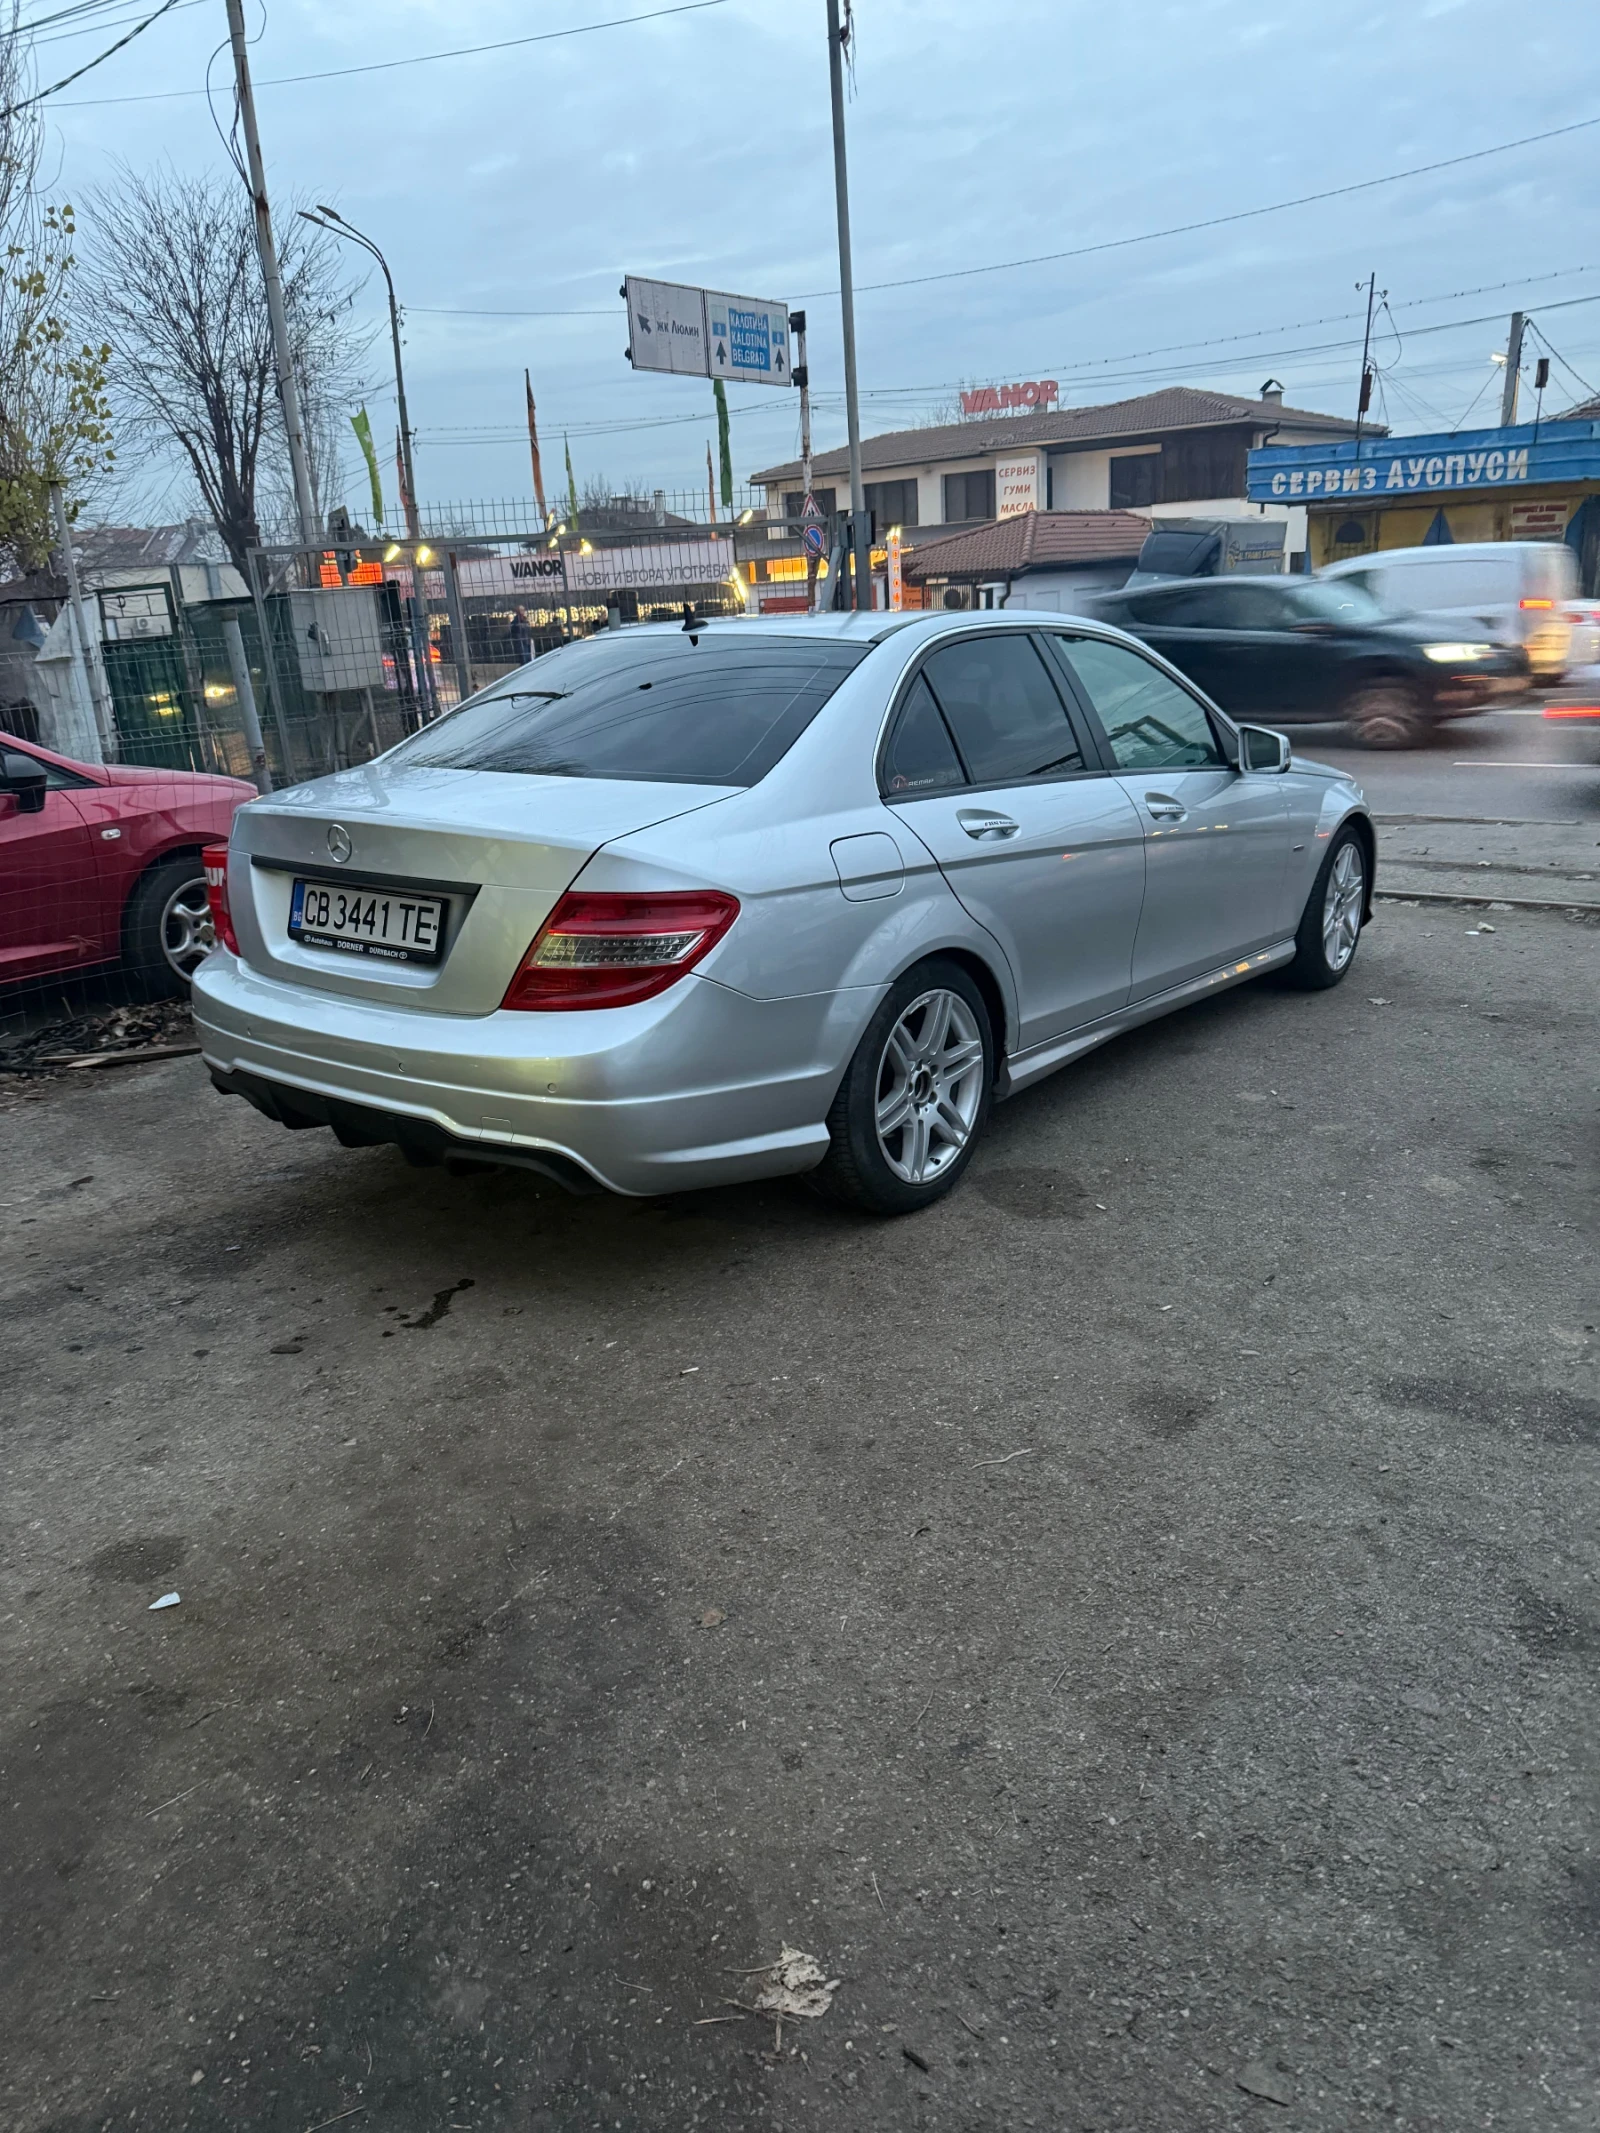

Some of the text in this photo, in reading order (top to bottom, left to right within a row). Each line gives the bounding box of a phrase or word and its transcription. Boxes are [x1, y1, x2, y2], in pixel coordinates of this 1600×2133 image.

[672, 320, 699, 338] Люлин
[731, 331, 768, 349] KALOTINA
[732, 348, 765, 364] BELGRAD
[960, 379, 1059, 414] VIANOR
[998, 465, 1036, 478] СЕРВИЗ
[1271, 449, 1529, 495] СЕРВИЗ АУСПУСИ
[1003, 484, 1031, 496] ГУМИ
[1000, 502, 1035, 514] МАСЛА
[509, 559, 563, 578] VIANOR
[577, 563, 729, 586] НОВИ И ВТОРА УПОТРЕБА
[292, 911, 302, 922] BG
[305, 890, 434, 944] CB 3441 TE
[310, 936, 333, 947] Autohaus
